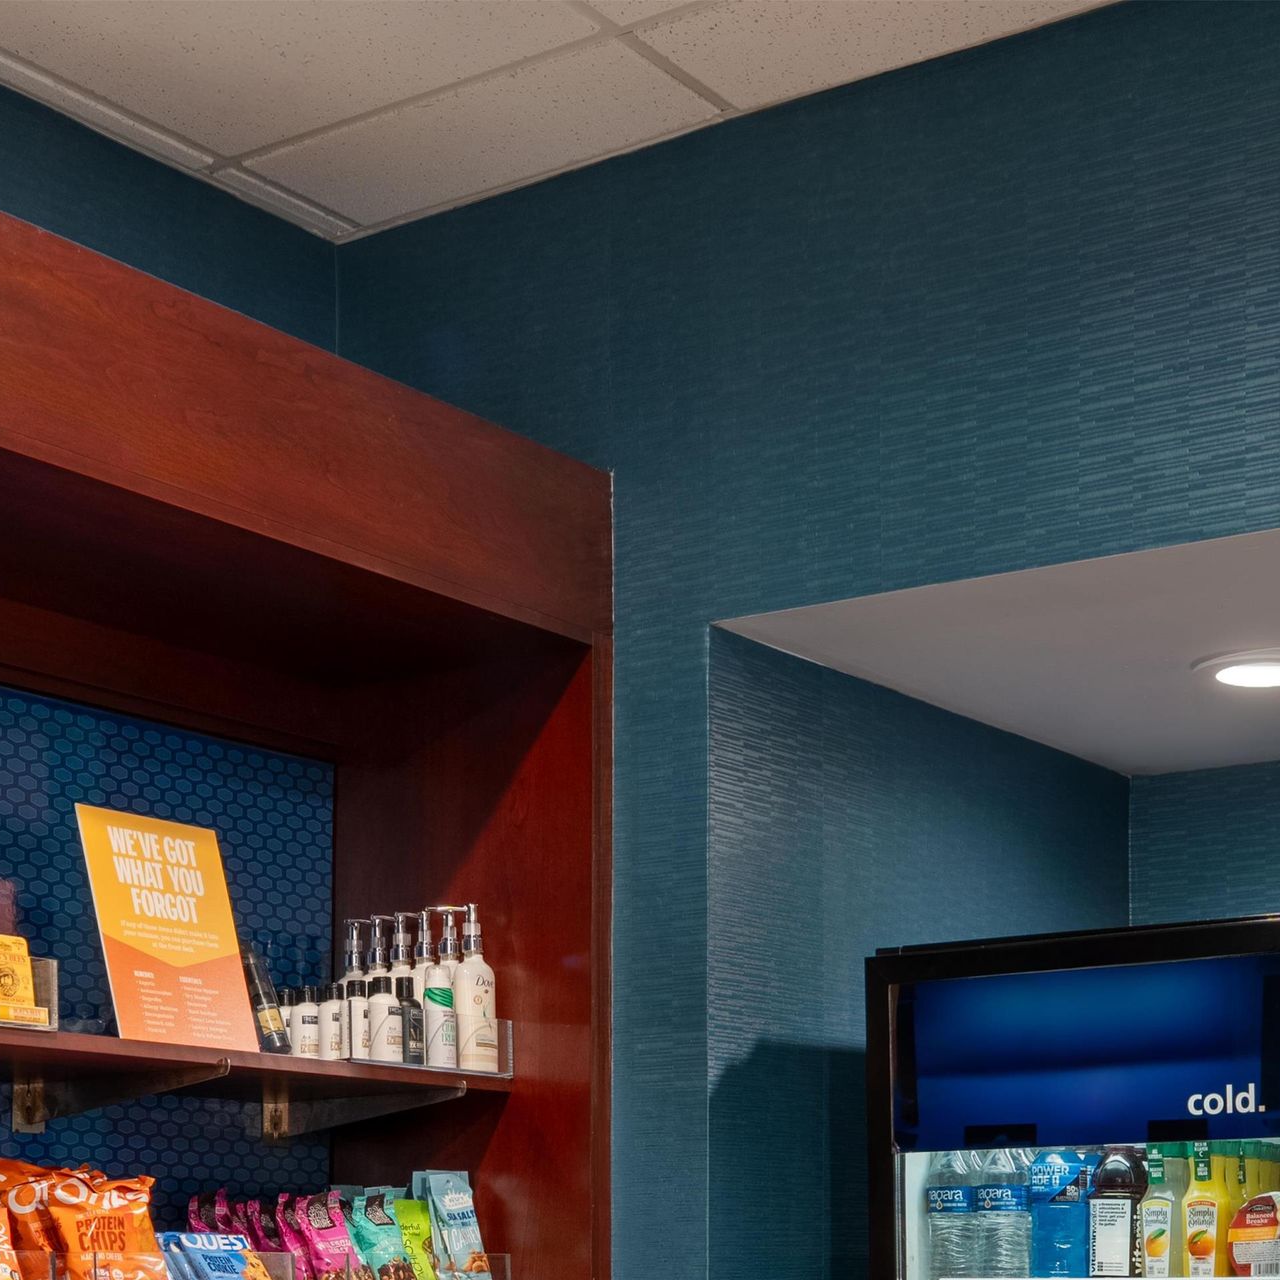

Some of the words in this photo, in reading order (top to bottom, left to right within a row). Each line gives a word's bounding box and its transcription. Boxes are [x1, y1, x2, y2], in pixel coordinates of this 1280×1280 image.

[107, 825, 163, 860] WE'VE
[164, 836, 196, 867] GOT
[113, 856, 163, 889] WHAT
[166, 865, 204, 896] YOU
[131, 888, 198, 923] FORGOT
[1187, 1083, 1267, 1115] cold.
[1032, 1165, 1069, 1176] POWER
[1032, 1176, 1050, 1185] ADE
[458, 1211, 474, 1220] SALT
[1188, 1208, 1214, 1218] Simply
[76, 1216, 125, 1232] PROTEIN
[79, 1230, 126, 1251] CHIPS
[202, 1254, 233, 1264] PROTEIN
[207, 1261, 239, 1274] COOKIE
